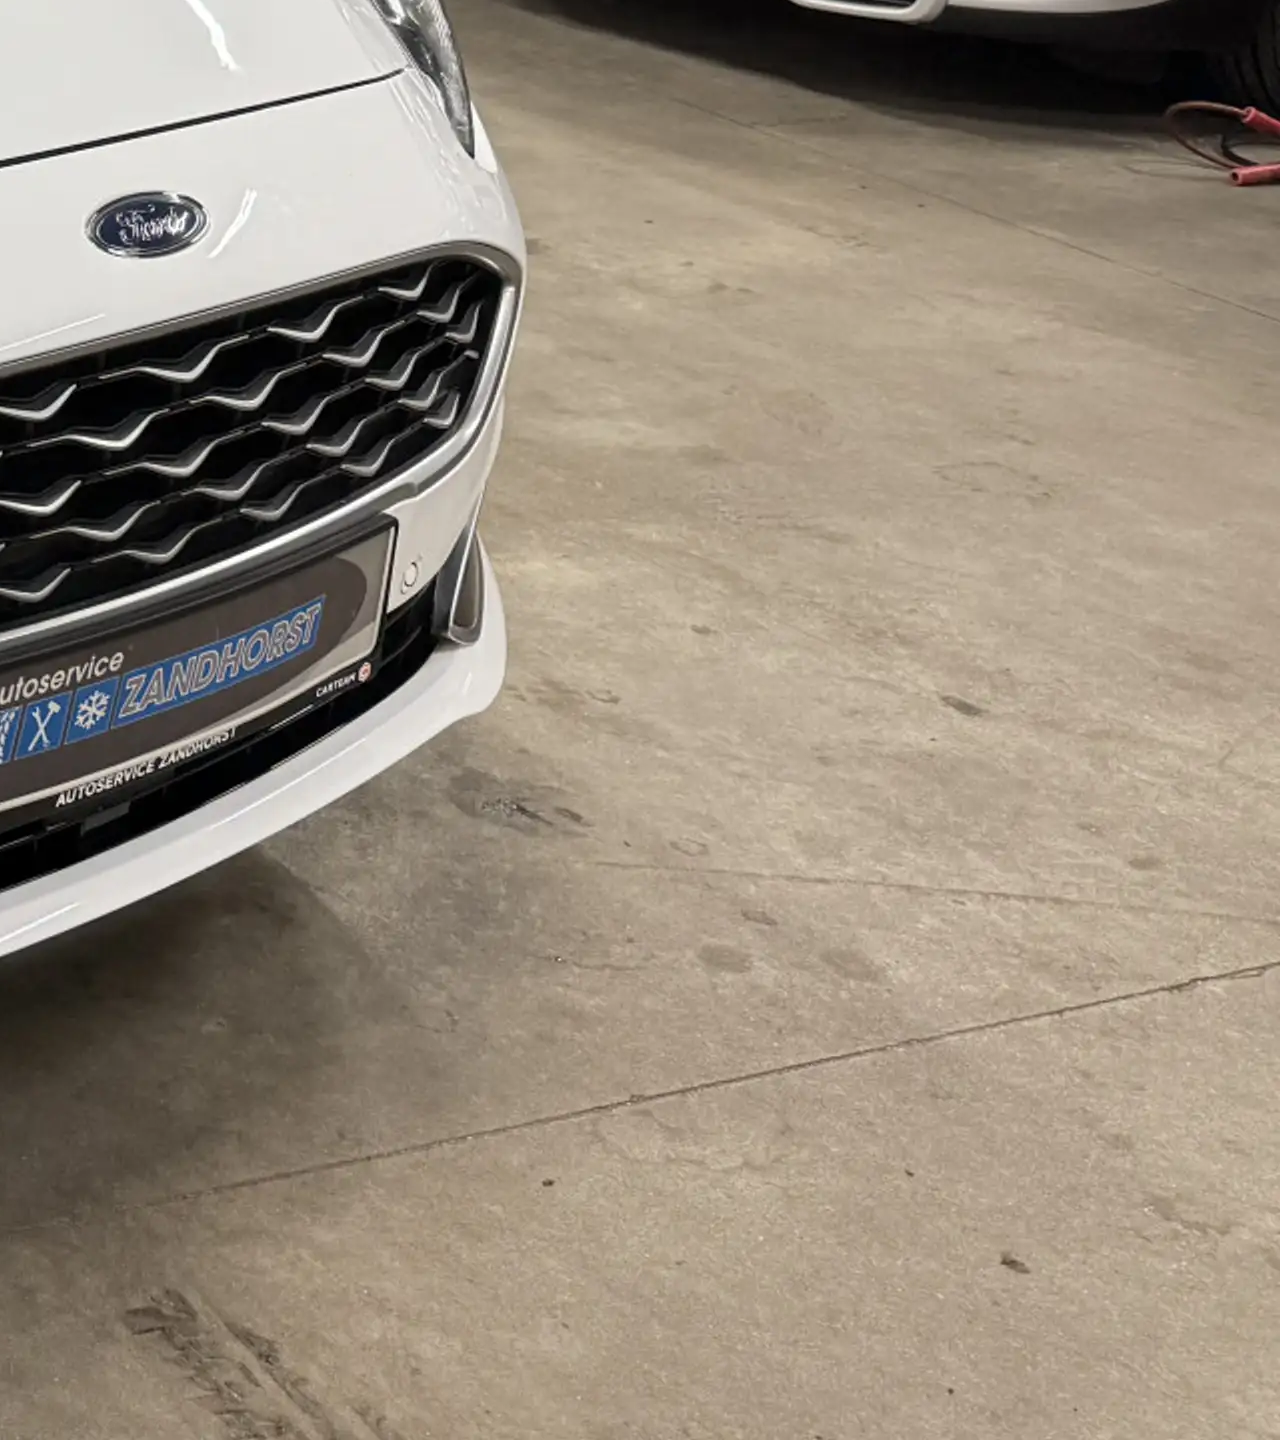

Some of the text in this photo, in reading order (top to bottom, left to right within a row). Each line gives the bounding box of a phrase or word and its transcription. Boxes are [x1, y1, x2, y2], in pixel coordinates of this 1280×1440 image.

[118, 601, 323, 719] ZANDHORST
[54, 725, 238, 808] AUTOSERVICE ZANDHORST
